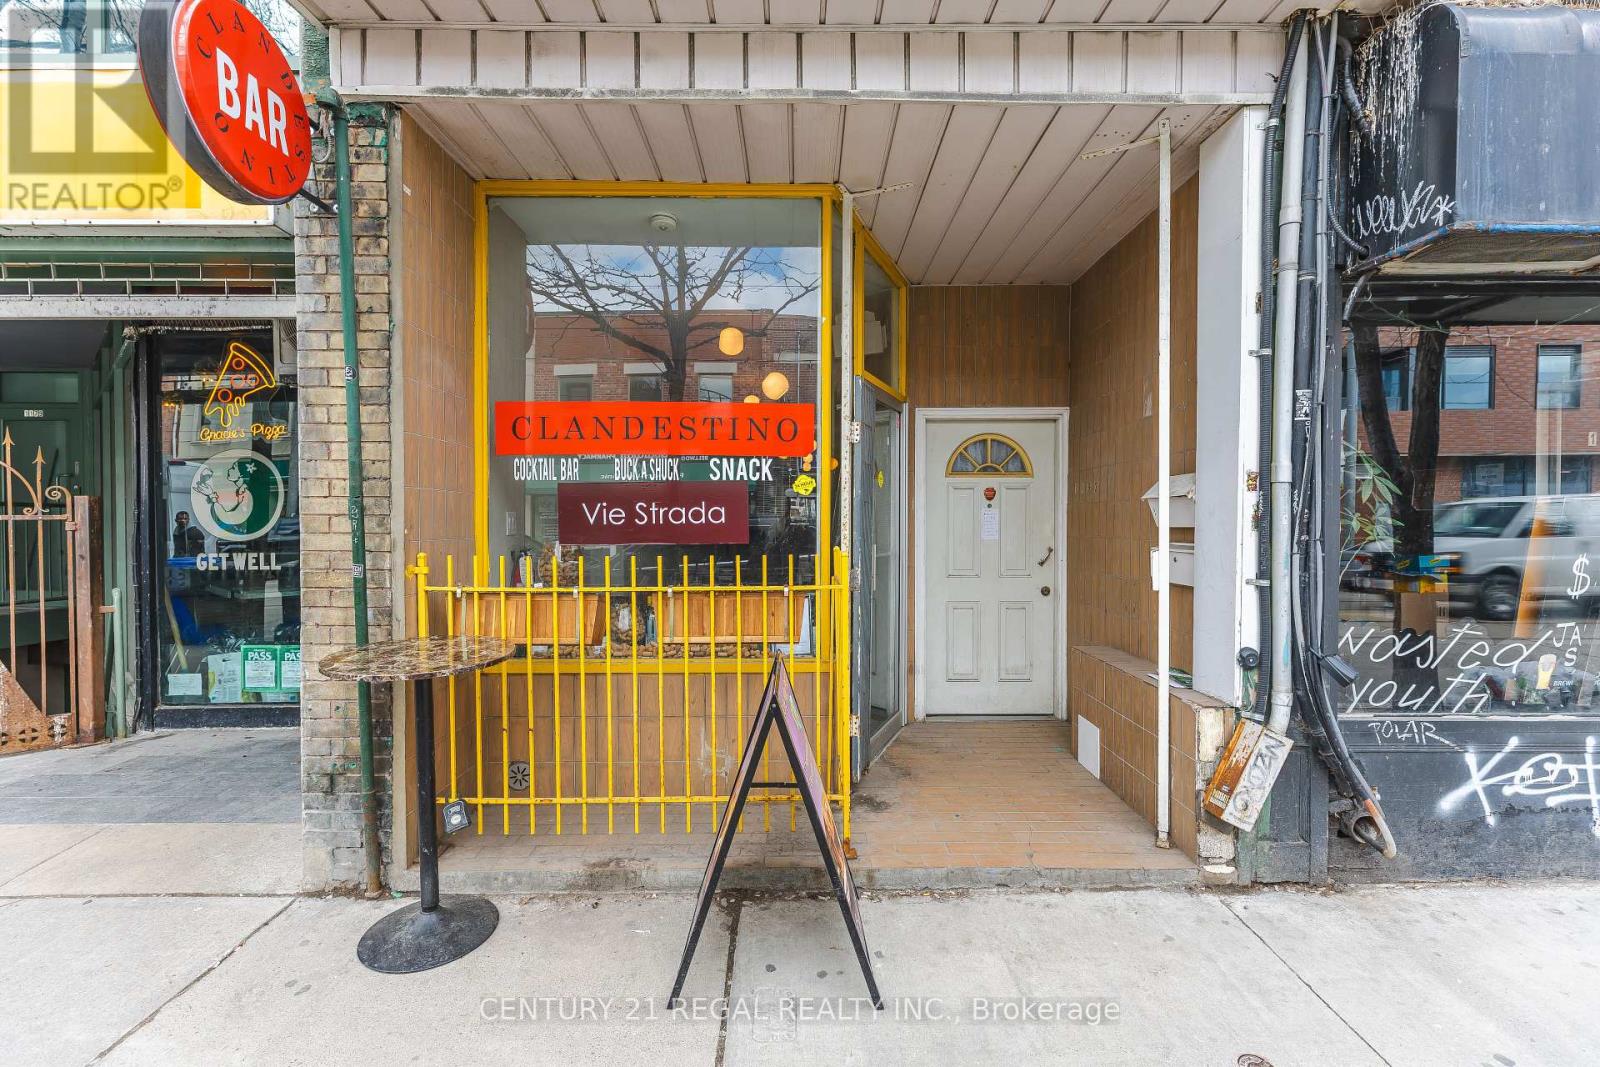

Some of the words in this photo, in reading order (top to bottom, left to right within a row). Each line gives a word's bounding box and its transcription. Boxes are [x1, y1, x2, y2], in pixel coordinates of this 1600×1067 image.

[216, 47, 289, 157] BAR
[251, 423, 287, 441] Pizza
[511, 415, 800, 443] CLANDESTINO
[513, 458, 558, 481] COCKTAIL
[560, 458, 579, 481] BAR
[614, 458, 638, 481] BUCK
[640, 460, 647, 479] A
[649, 458, 680, 481] SHUCK
[709, 458, 774, 482] SNACK
[582, 502, 626, 526] Vie
[634, 501, 727, 526] Strada
[196, 552, 230, 571] GET
[232, 552, 282, 571] WELL
[248, 652, 272, 661] PASS
[284, 652, 301, 661] PAS
